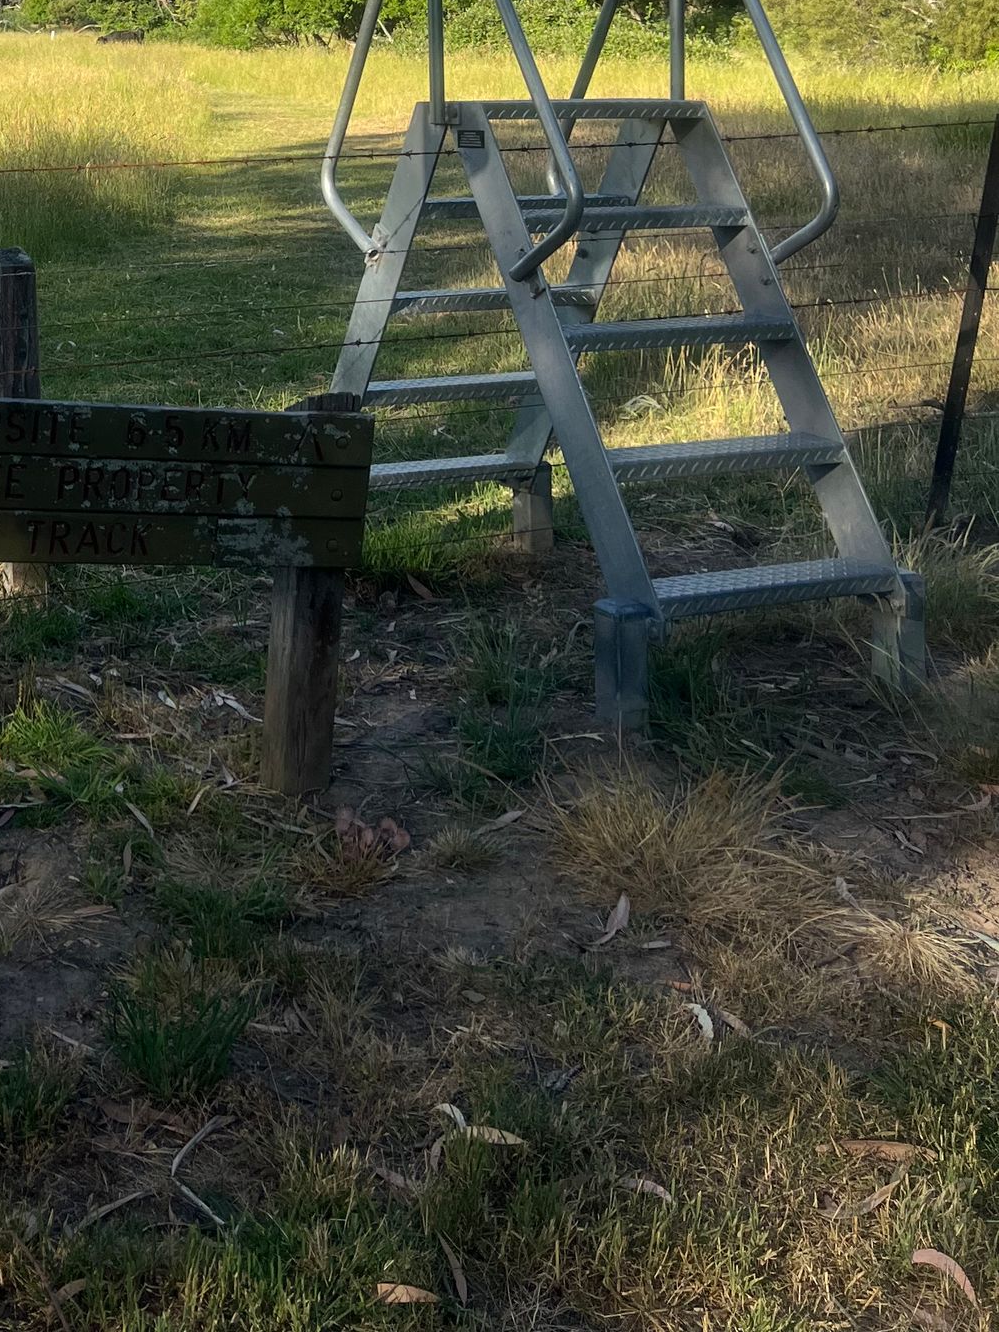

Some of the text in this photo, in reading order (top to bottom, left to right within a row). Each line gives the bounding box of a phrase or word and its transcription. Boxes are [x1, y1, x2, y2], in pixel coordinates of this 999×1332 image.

[201, 418, 251, 452] KM
[57, 465, 256, 505] PROPERTY
[26, 520, 153, 556] TRACK
